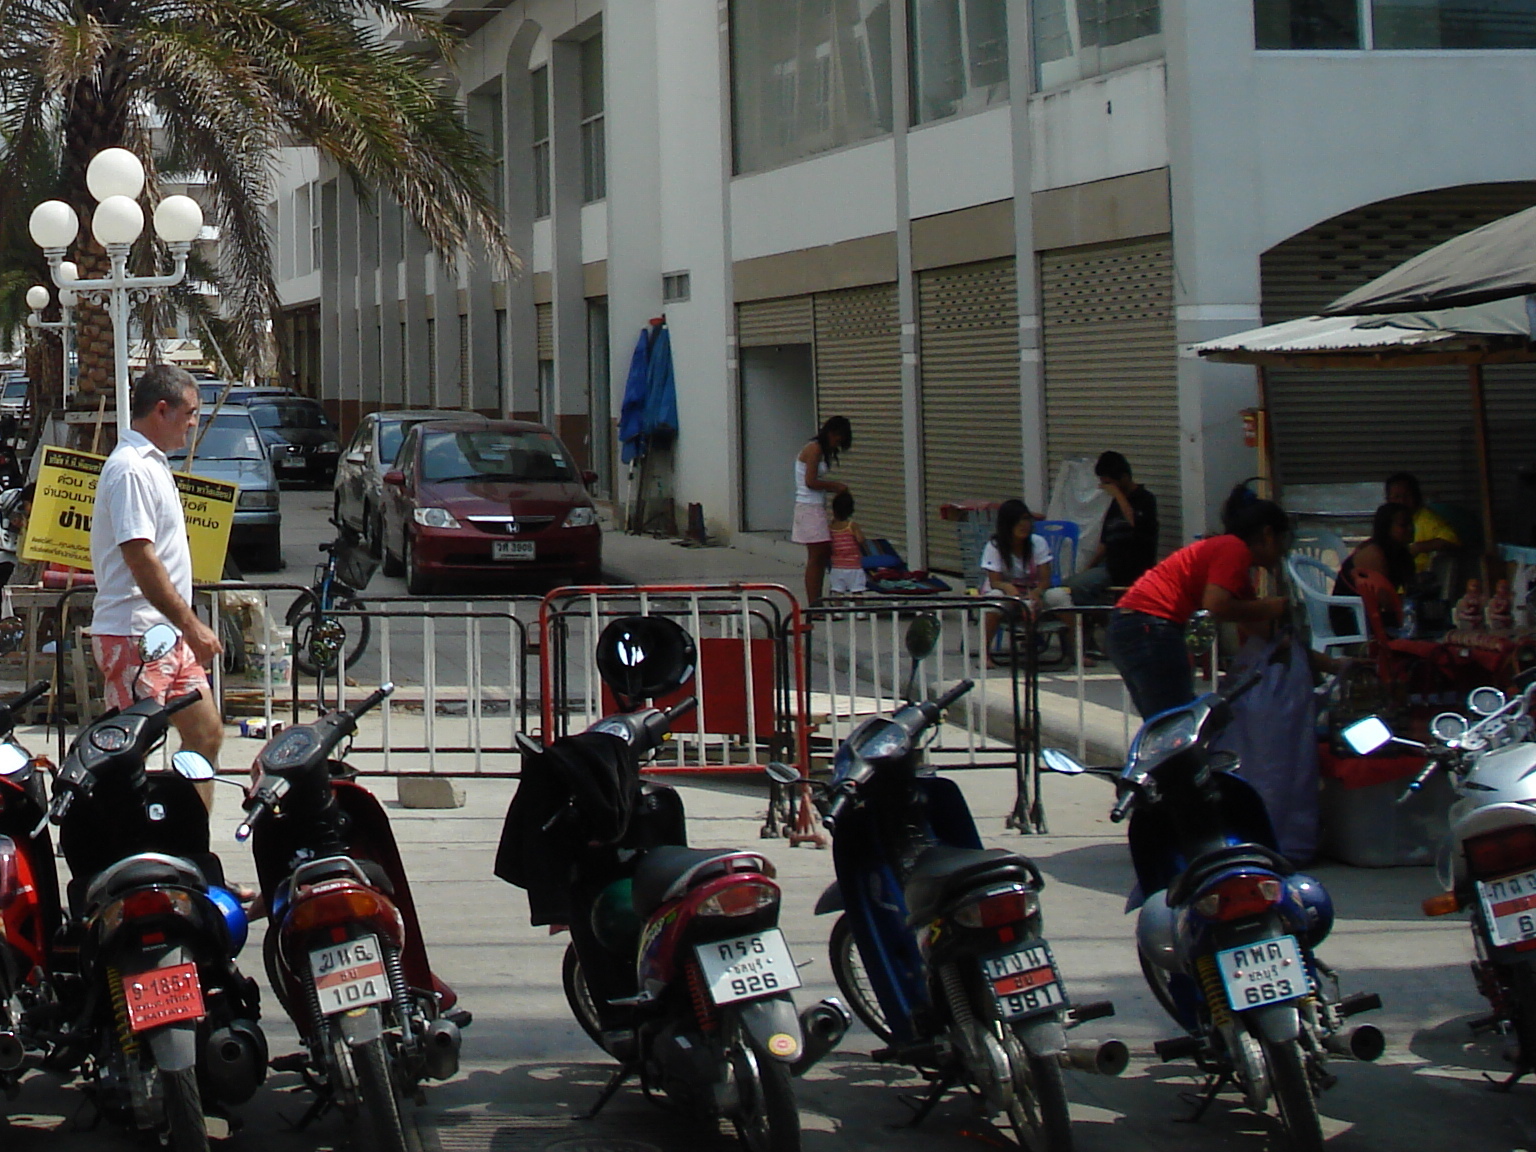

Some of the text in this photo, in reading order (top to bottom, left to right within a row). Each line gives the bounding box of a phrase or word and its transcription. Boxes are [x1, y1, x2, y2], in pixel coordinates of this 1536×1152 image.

[333, 980, 377, 1006] 104
[731, 972, 778, 996] 926
[1245, 979, 1293, 1004] 663
[1008, 987, 1053, 1014] 981
